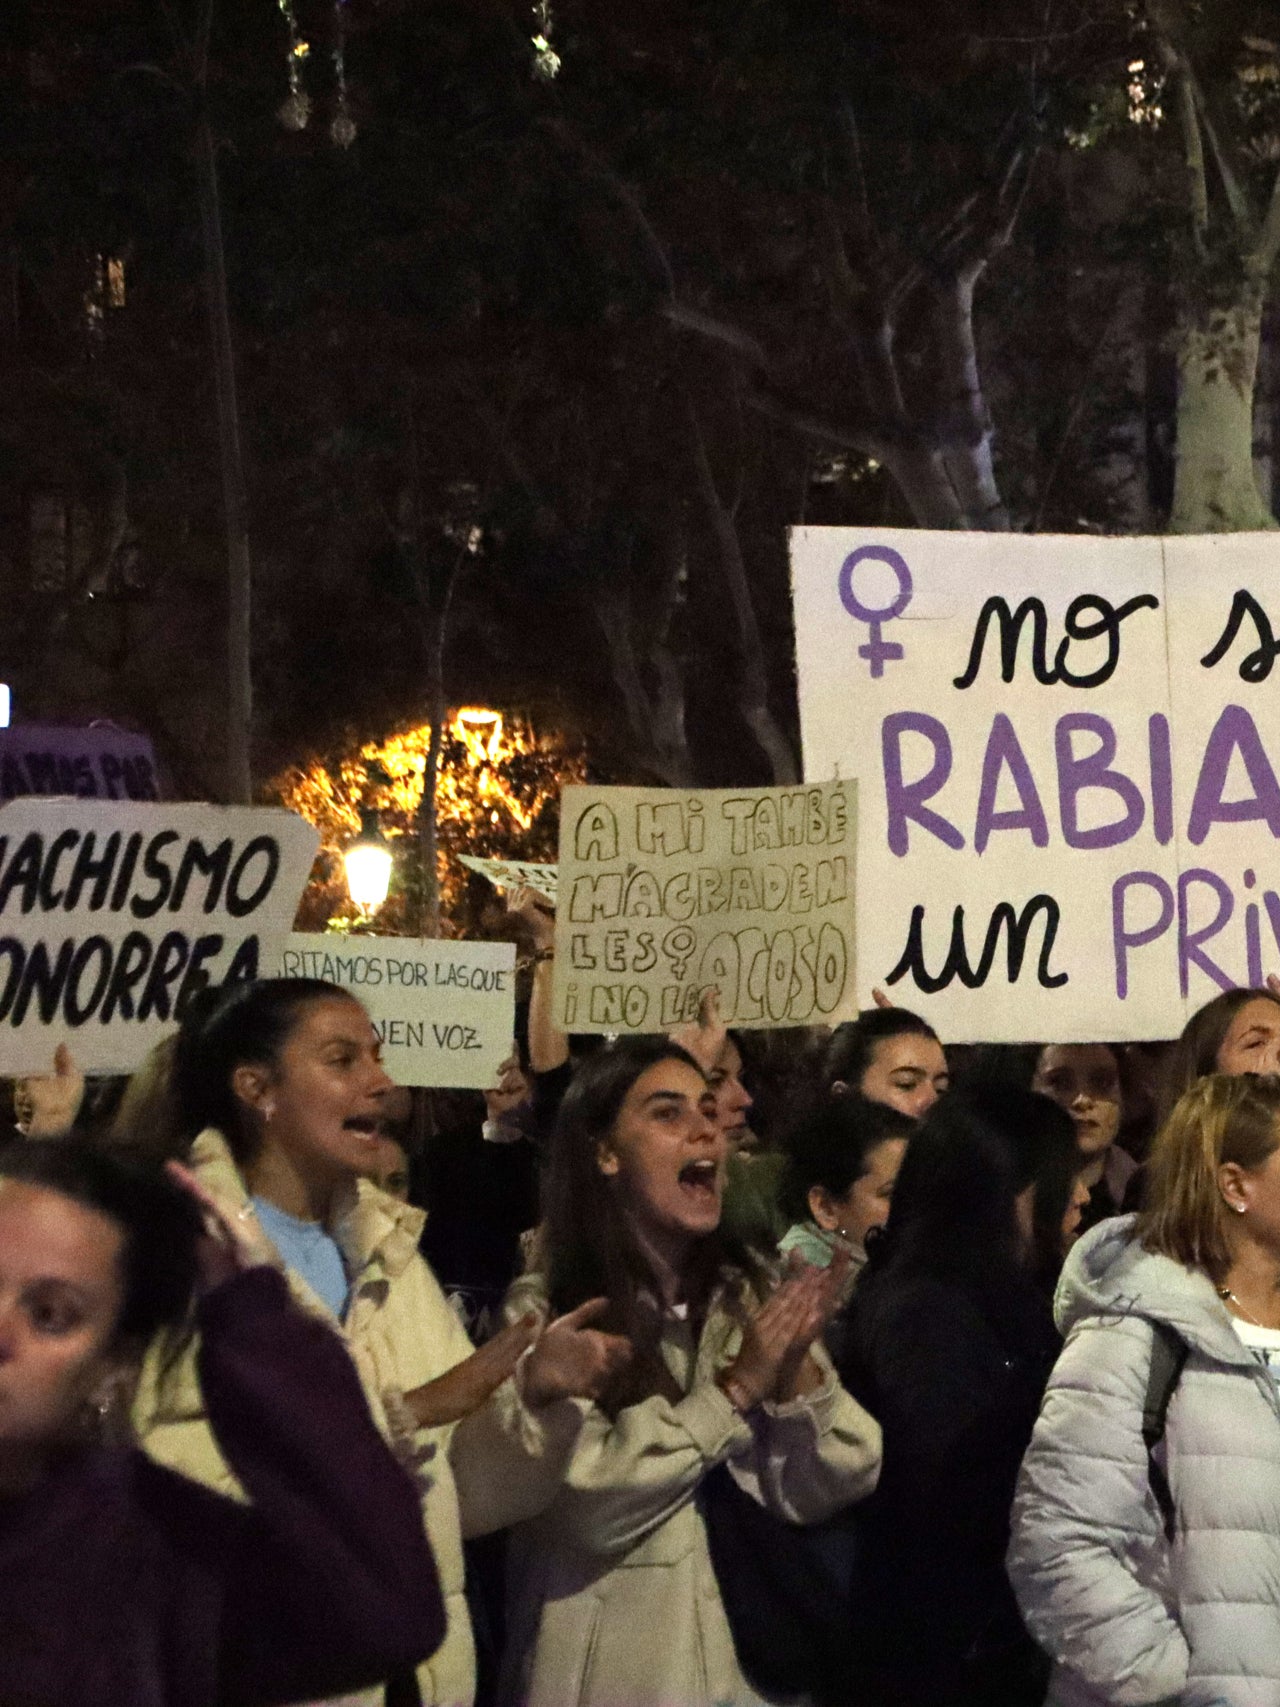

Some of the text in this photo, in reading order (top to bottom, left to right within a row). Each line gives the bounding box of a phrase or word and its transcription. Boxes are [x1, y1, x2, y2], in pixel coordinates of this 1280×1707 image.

[953, 594, 1158, 689] no
[574, 802, 620, 861] A
[0, 829, 280, 918] ACHISMO
[278, 951, 507, 991] RITAMOS POR LAS QUE
[571, 929, 657, 973] LES
[589, 983, 649, 1028] NO
[699, 921, 848, 1023] ACOSO
[886, 893, 1068, 993] un
[432, 1024, 483, 1050] VOZ
